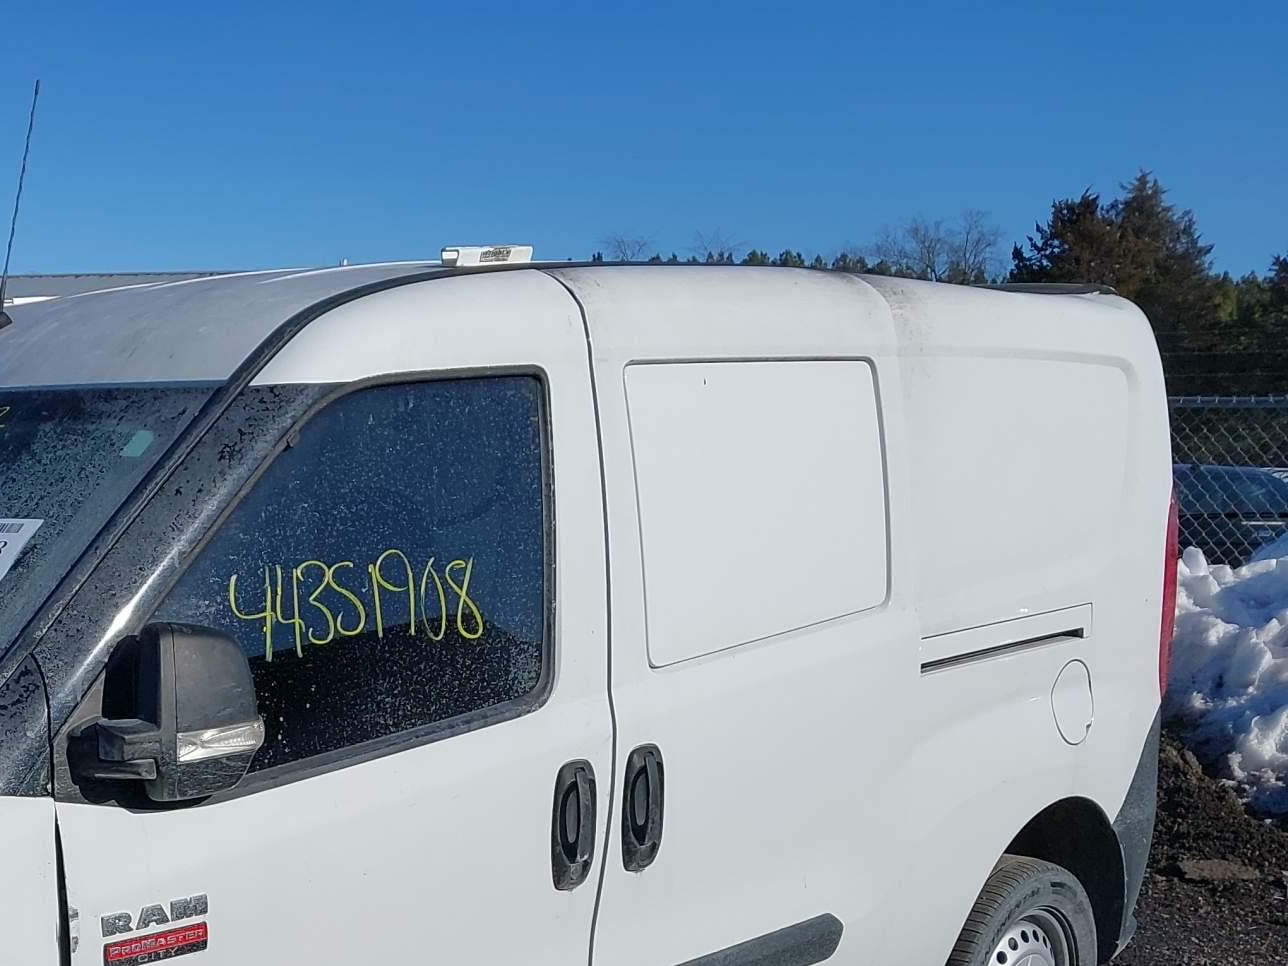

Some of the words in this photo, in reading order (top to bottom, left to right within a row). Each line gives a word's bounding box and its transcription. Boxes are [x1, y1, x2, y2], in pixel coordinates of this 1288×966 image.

[229, 549, 484, 662] 44351908
[101, 893, 209, 938] RAM
[137, 946, 181, 963] CITY
